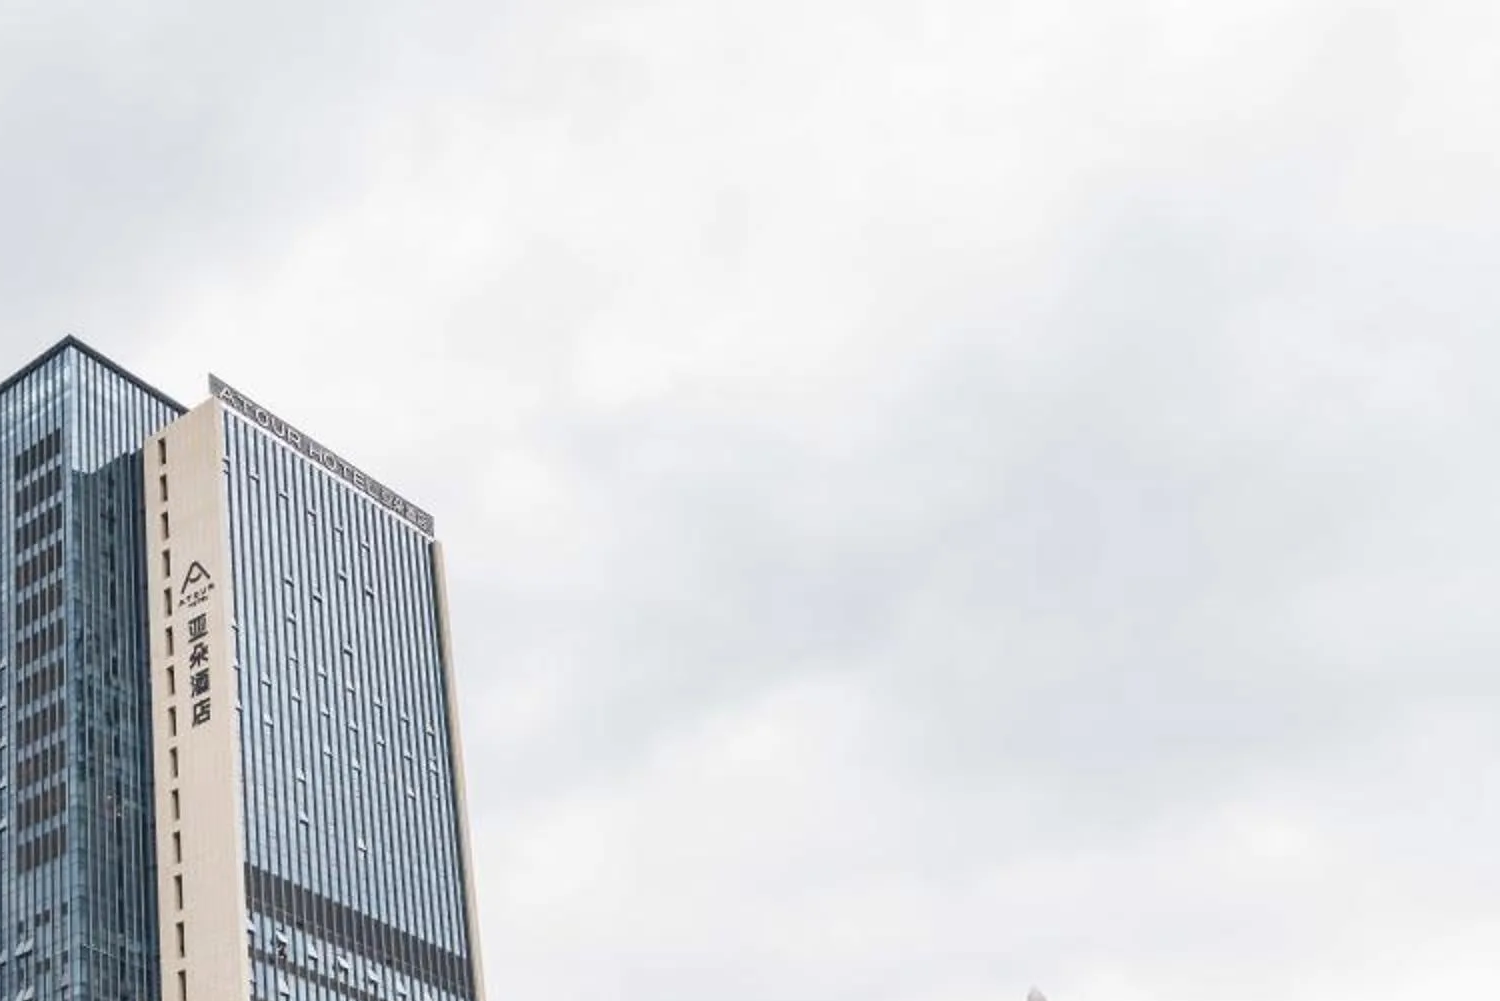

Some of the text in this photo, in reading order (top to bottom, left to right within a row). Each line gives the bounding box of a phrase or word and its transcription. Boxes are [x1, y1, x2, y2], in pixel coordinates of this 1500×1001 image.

[220, 386, 380, 499] ATOUR HOTEL
[188, 613, 211, 727] 亚朵酒店
